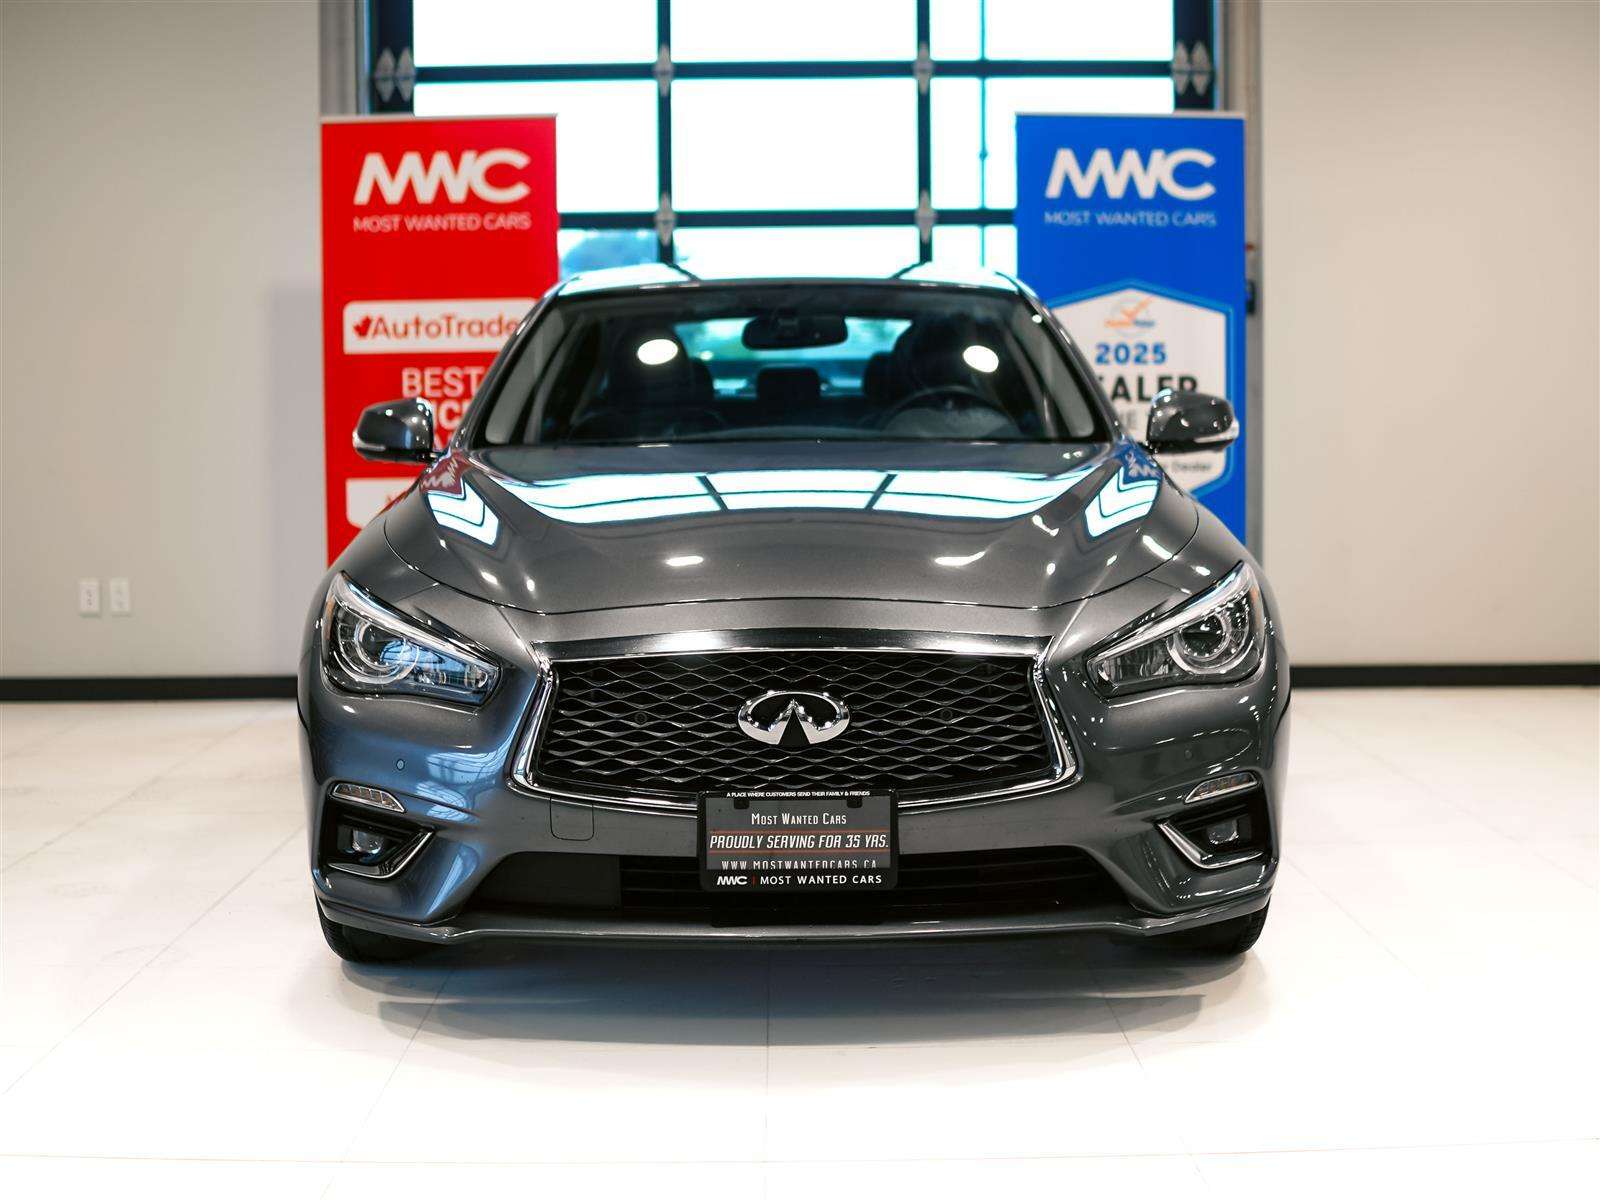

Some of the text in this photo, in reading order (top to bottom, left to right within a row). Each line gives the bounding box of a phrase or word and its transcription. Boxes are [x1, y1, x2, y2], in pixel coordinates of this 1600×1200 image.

[353, 148, 531, 205] MWC
[1045, 148, 1217, 201] MWC
[353, 211, 532, 233] MOST WANTED CARS
[1044, 210, 1217, 228] MOST WANTED CARS
[372, 313, 519, 339] AutoTrade
[1095, 342, 1167, 365] 2025
[402, 365, 486, 398] BEST
[1099, 375, 1198, 401] ALER
[709, 834, 889, 849] PROUDLY SERVING FOR 35 YRS.
[716, 875, 882, 886] MWC MOST WANTED CARS
